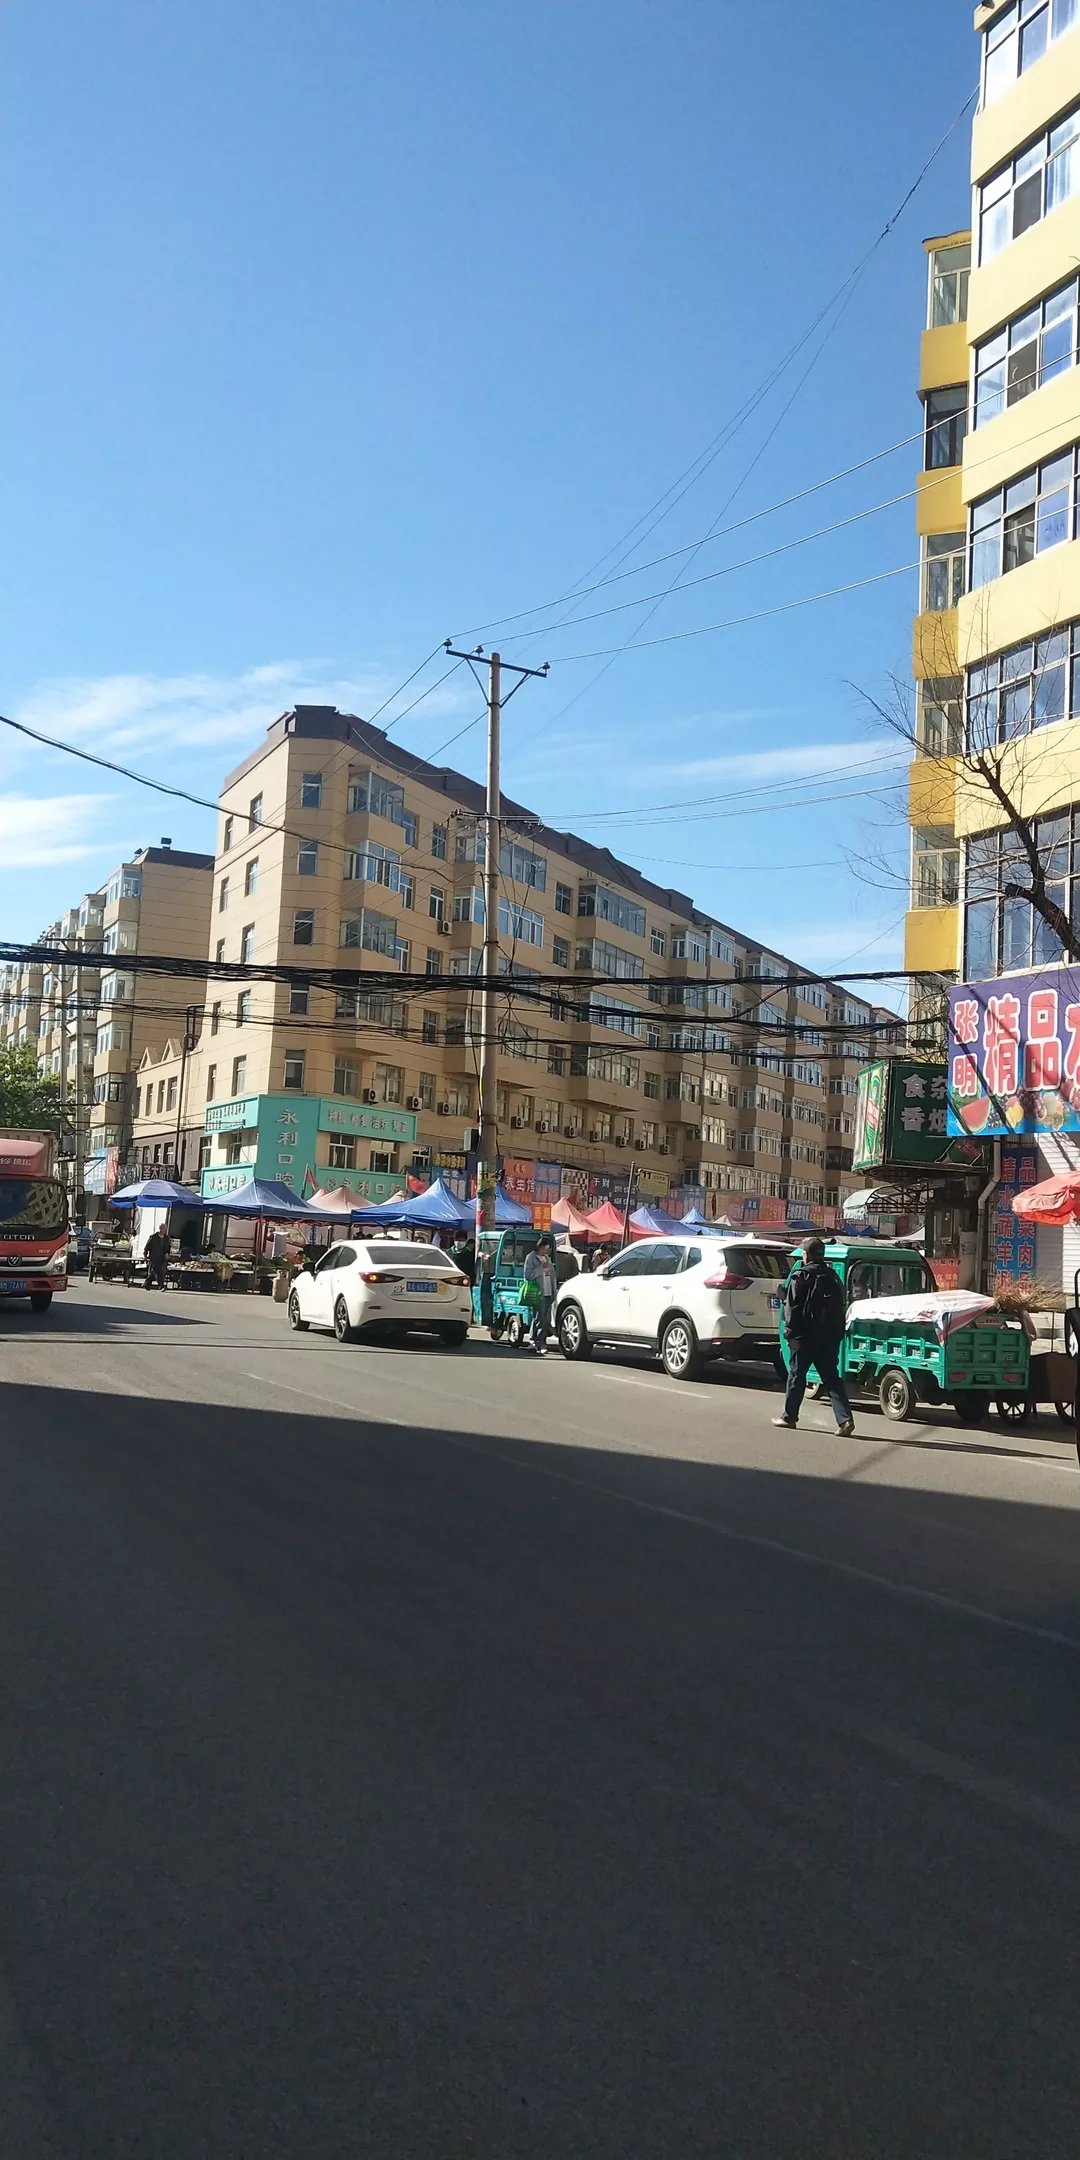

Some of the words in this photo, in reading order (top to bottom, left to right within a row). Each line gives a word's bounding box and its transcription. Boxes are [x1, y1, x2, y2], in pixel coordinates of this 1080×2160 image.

[953, 999, 979, 1096] 张明
[902, 1073, 947, 1099] 食杂
[900, 1106, 947, 1132] 香烟
[1000, 1157, 1036, 1183] 精品
[997, 1241, 1034, 1267] 羊肉
